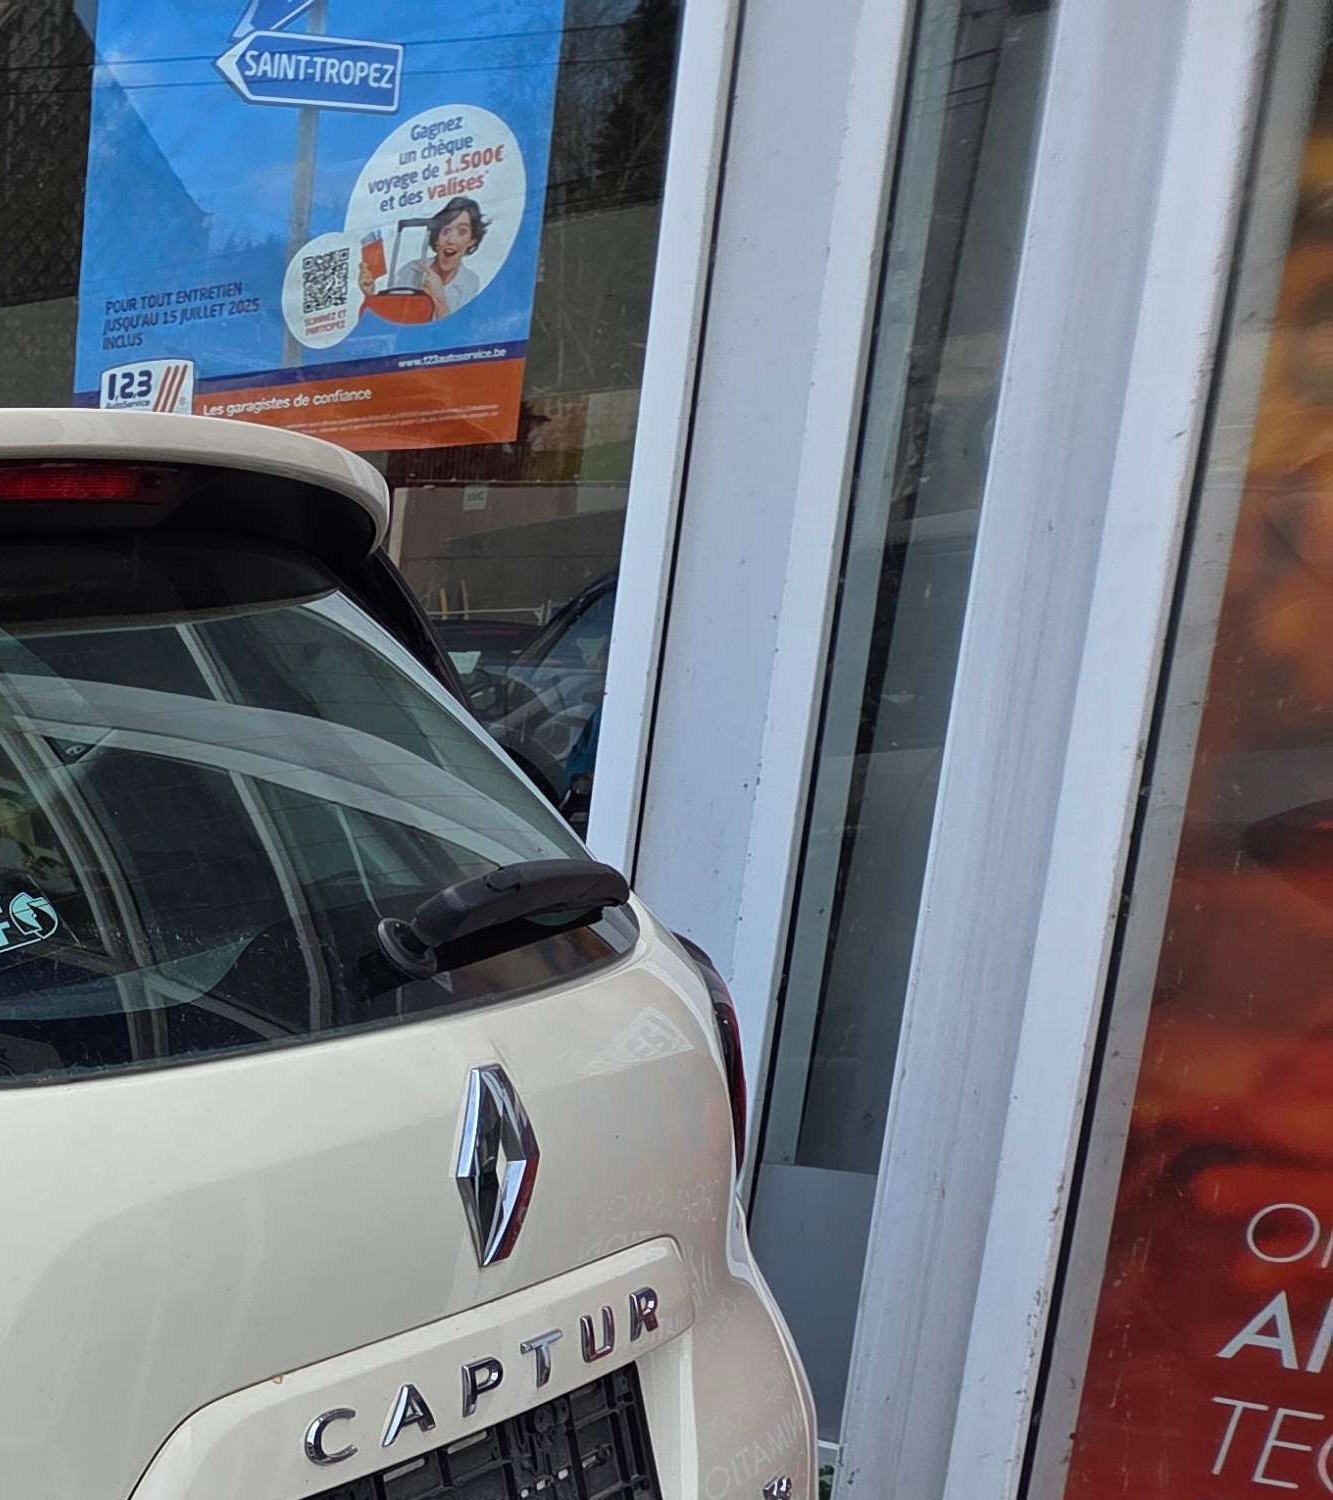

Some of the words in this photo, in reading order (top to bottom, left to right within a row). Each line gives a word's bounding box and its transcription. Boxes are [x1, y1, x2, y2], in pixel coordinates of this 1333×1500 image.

[244, 49, 396, 89] SAINT-TROPEZ
[410, 115, 464, 142] Gagnez
[398, 150, 418, 166] un
[420, 135, 474, 160] chèque
[367, 169, 419, 195] voyage
[422, 164, 440, 181] de
[444, 144, 506, 176] 1.500€
[379, 196, 395, 212] et
[398, 189, 424, 208] des
[102, 312, 159, 337] JUSQU'AU
[162, 309, 178, 325] 15
[178, 302, 226, 326] JUILLET
[227, 297, 261, 316] 2025
[104, 298, 138, 316] POUR
[139, 292, 174, 310] TOUT
[175, 282, 243, 305] ENTRETIEN
[101, 332, 144, 351] INCLUS
[202, 403, 224, 417] Les
[226, 397, 291, 418] garagistes
[293, 394, 310, 408] de
[312, 388, 373, 406] confiance
[1247, 1202, 1333, 1269] O
[303, 1286, 660, 1467] CAPTUR
[1211, 1396, 1333, 1493] TE
